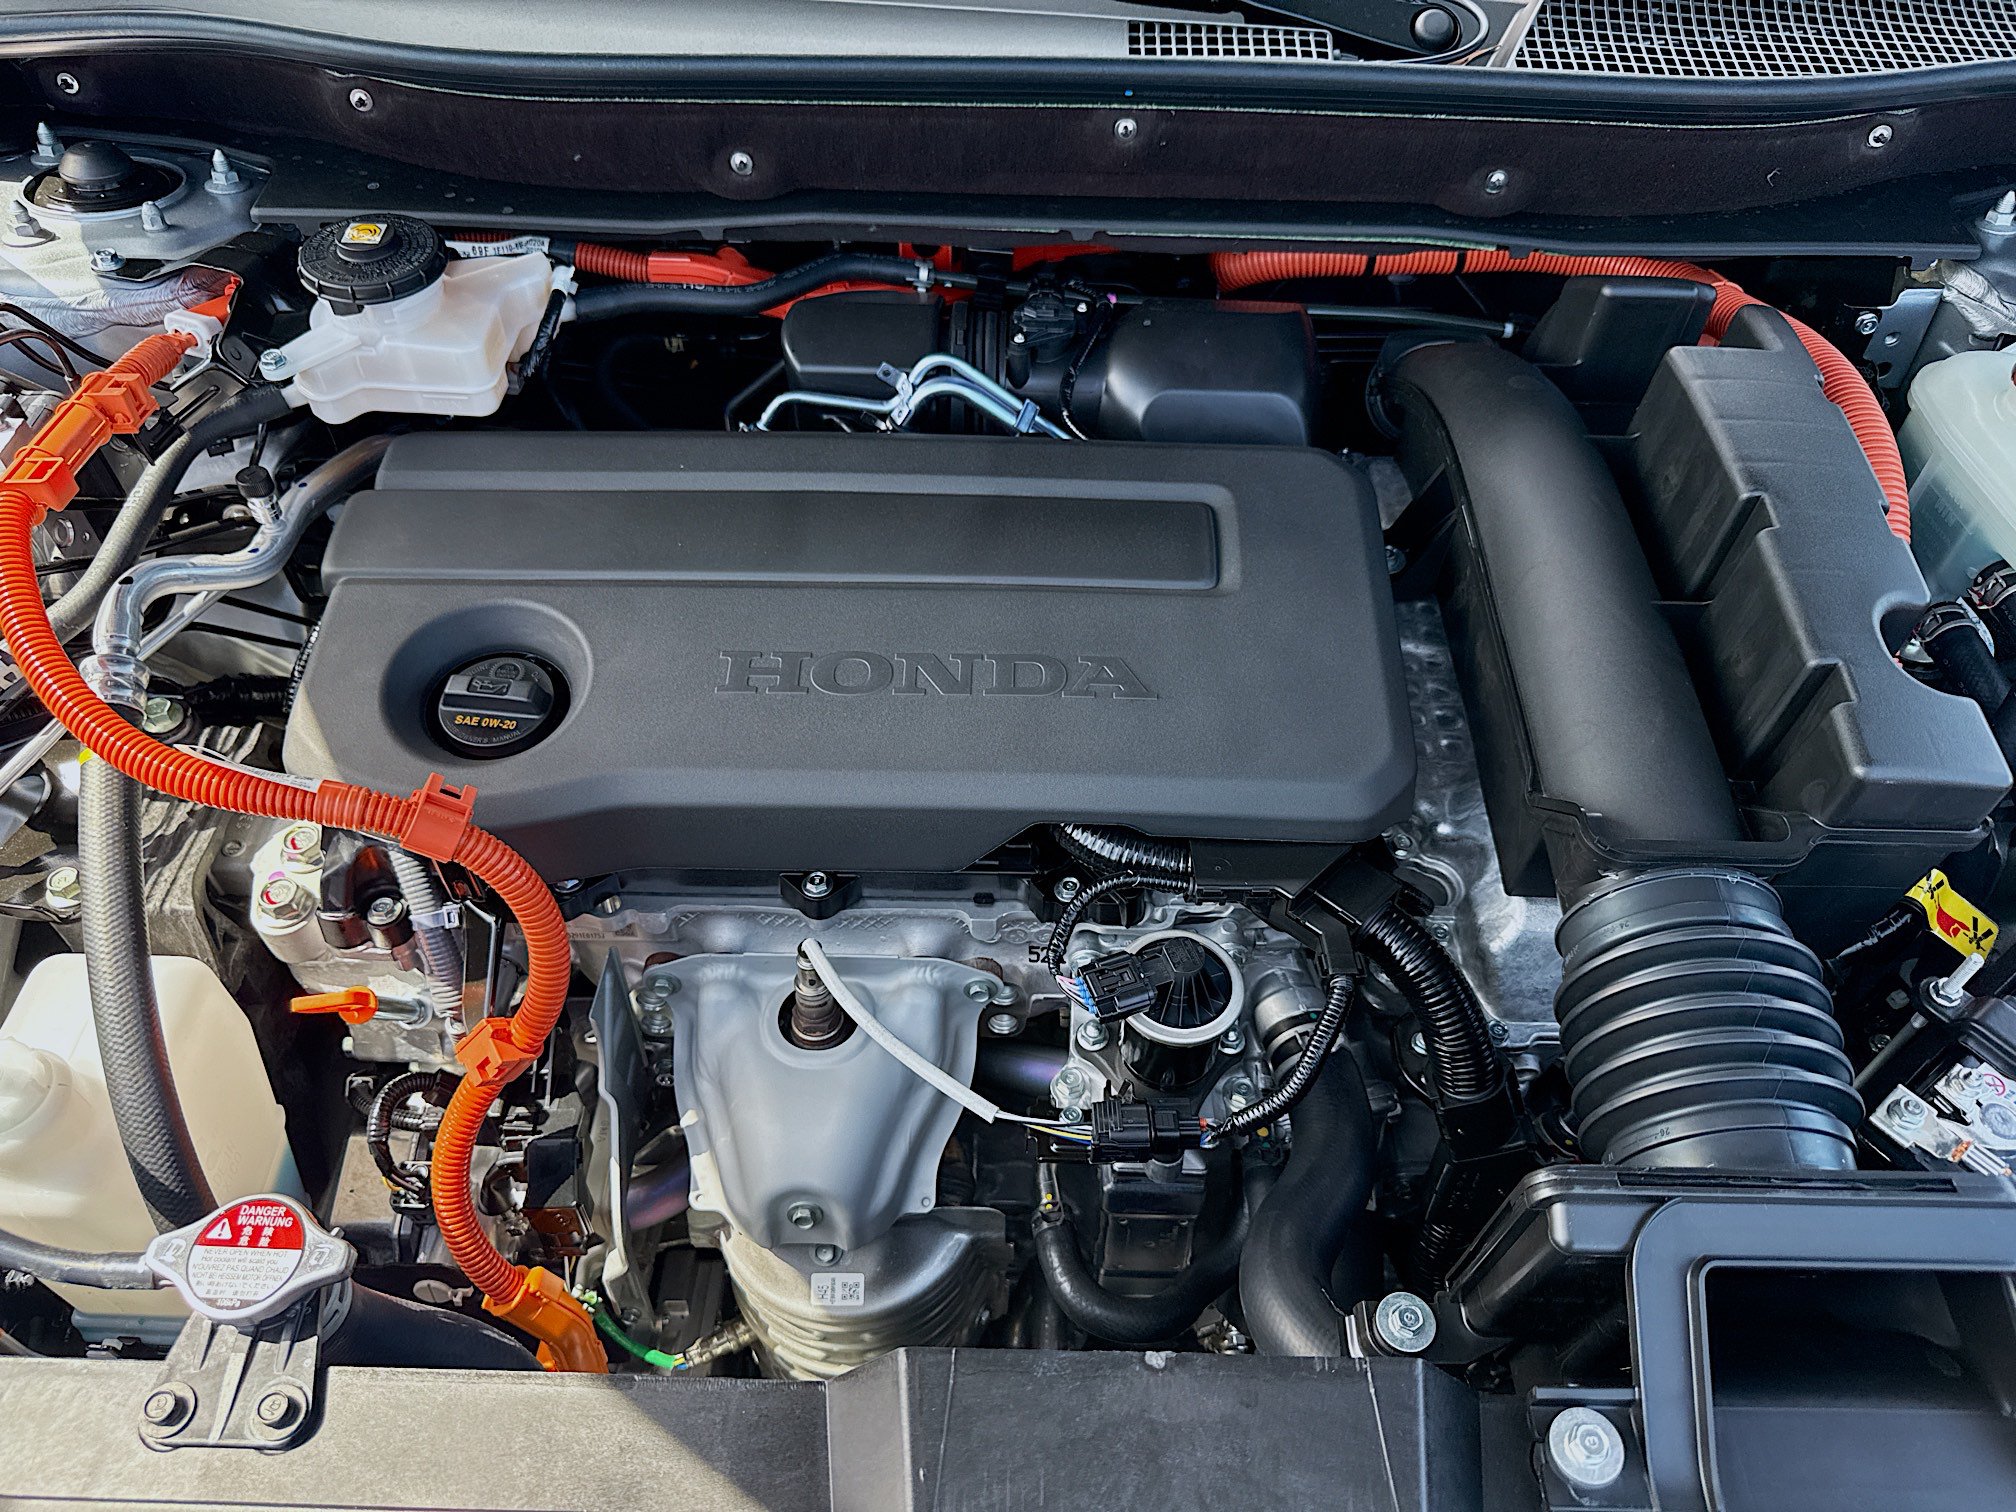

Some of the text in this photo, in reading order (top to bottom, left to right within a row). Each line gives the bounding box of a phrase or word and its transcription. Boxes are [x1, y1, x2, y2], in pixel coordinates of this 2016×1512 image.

[714, 651, 1159, 699] HONDA
[454, 715, 517, 730] SAE 0W-20
[240, 1204, 287, 1217] DANGER
[237, 1215, 294, 1228] WARNUNG
[204, 1248, 229, 1256] NEVER
[250, 1249, 271, 1257] WHEN
[274, 1250, 288, 1258] HOT
[226, 1264, 239, 1272] PAS
[241, 1265, 264, 1273] QUAND
[265, 1266, 289, 1274] CHAUD
